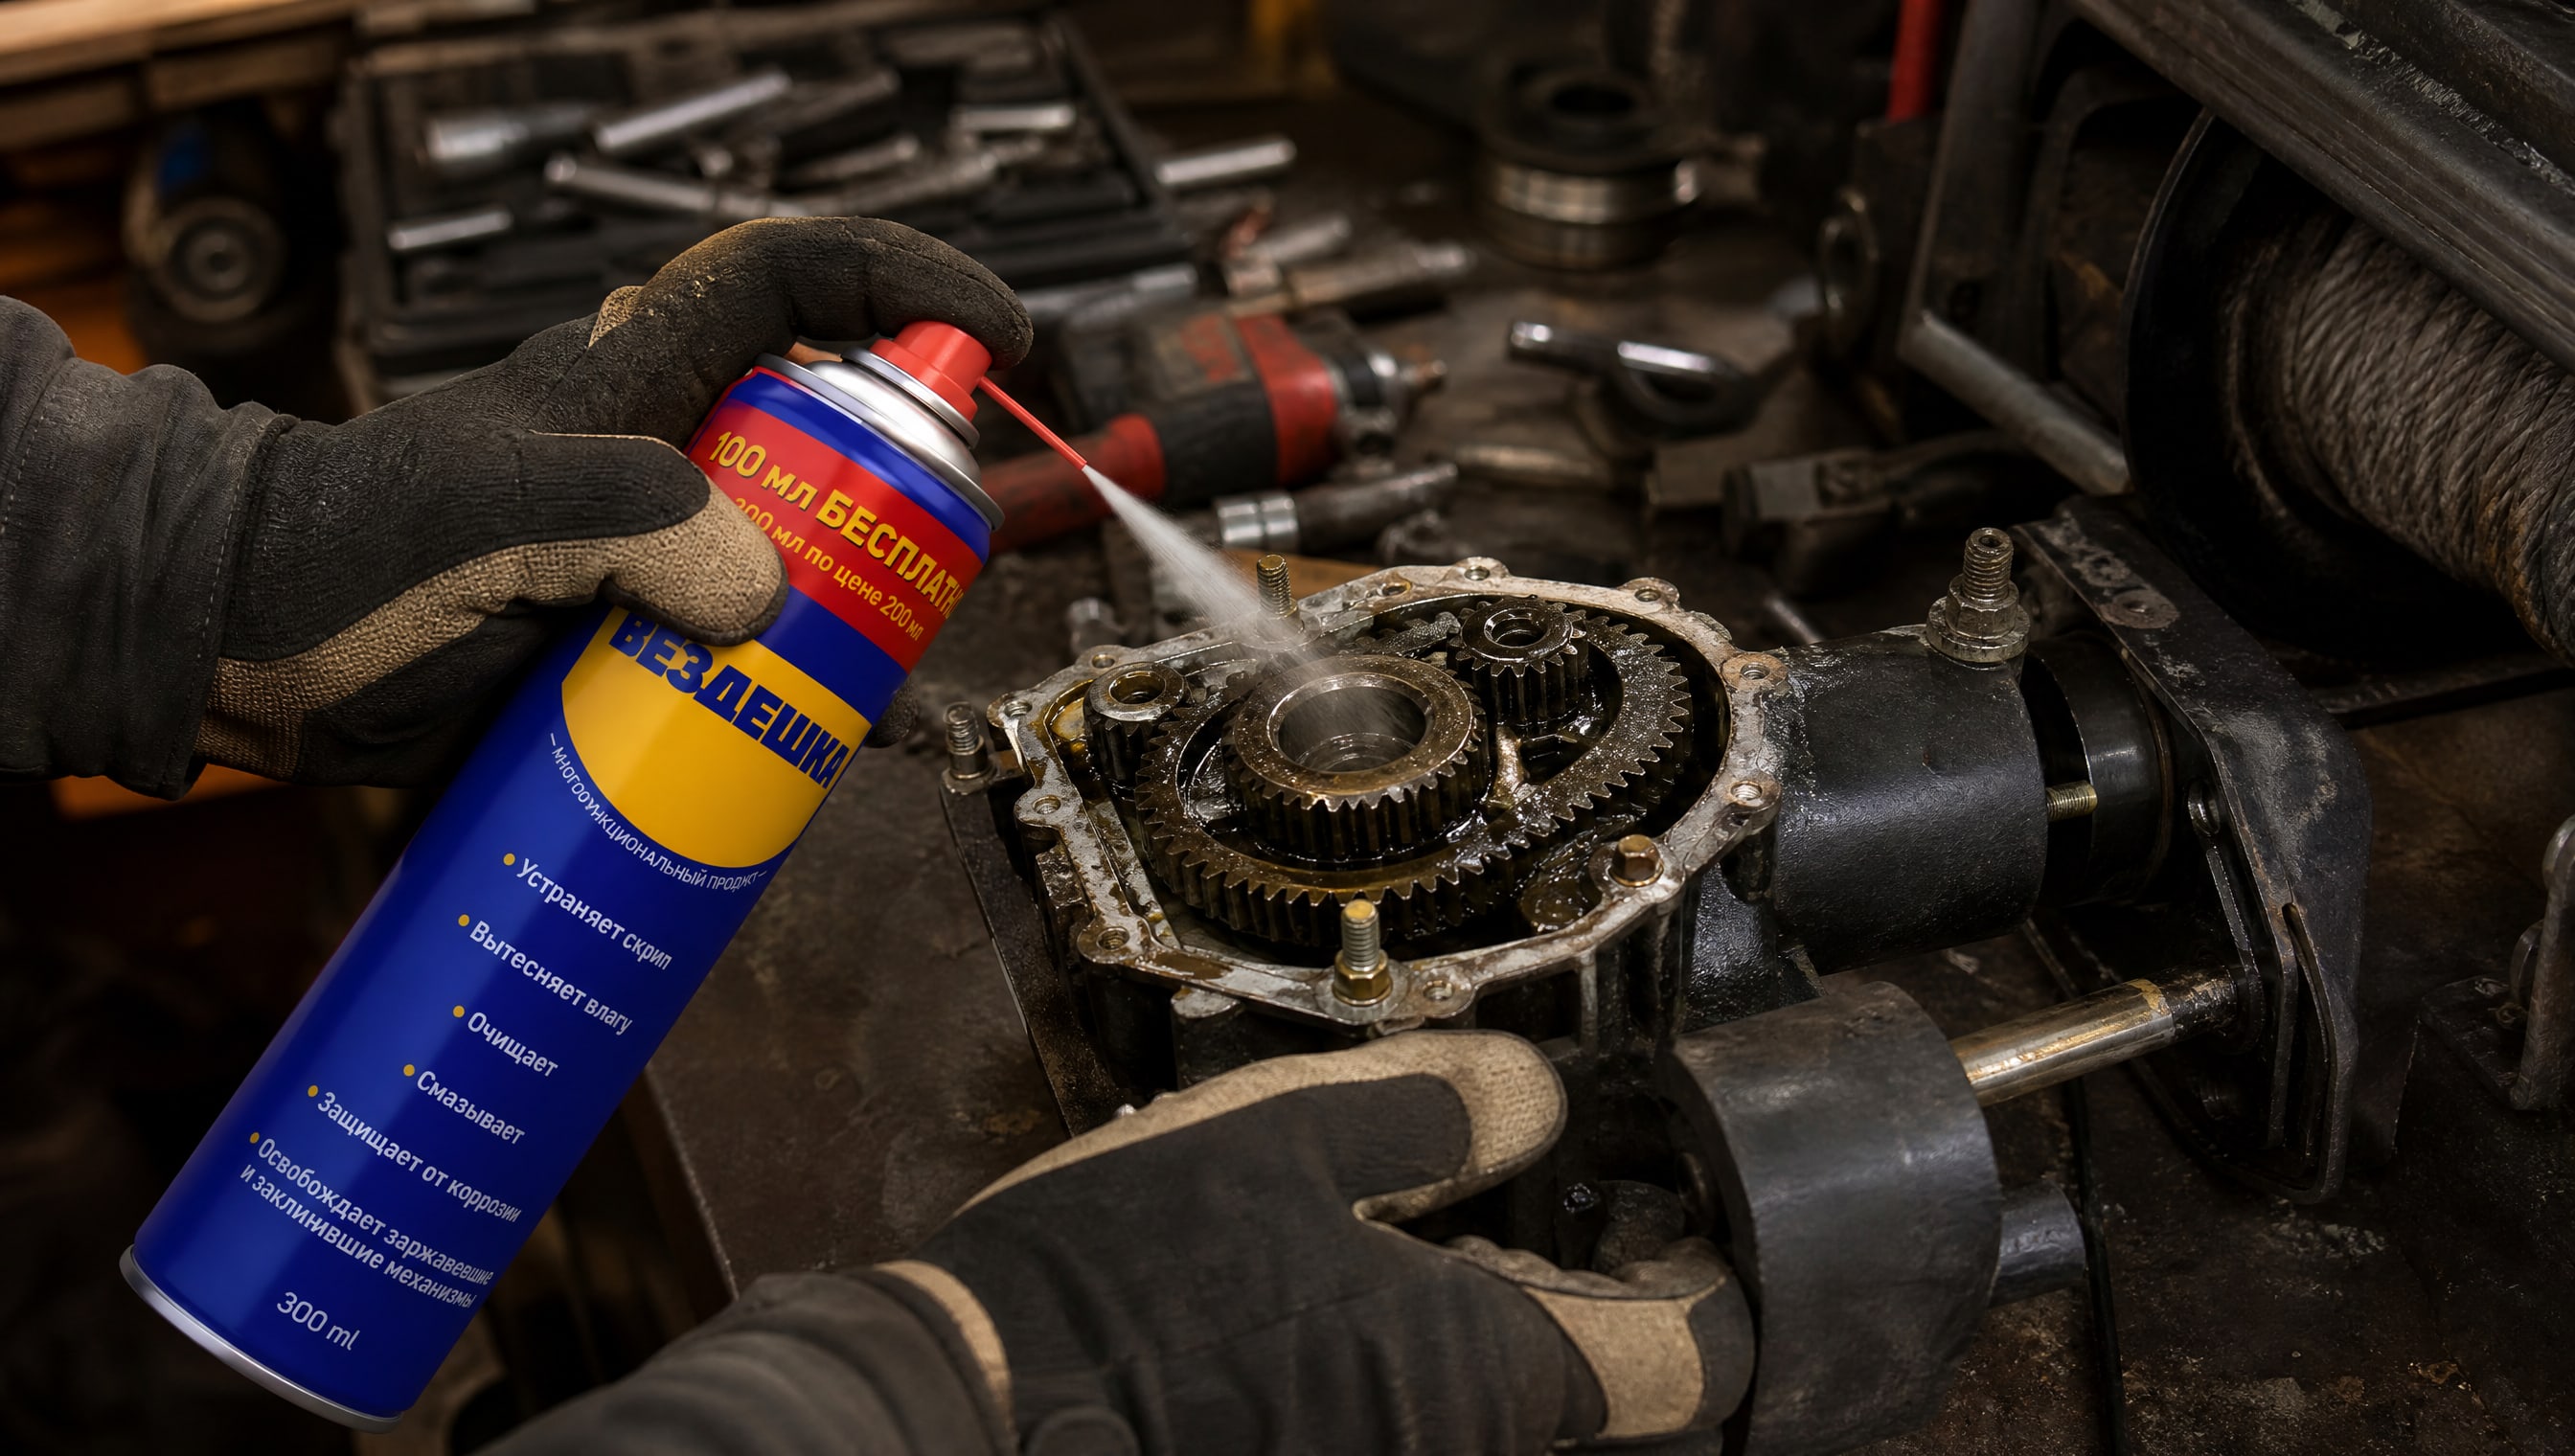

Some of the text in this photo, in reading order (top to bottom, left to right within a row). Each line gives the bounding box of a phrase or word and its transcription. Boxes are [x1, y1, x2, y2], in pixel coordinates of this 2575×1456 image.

[708, 431, 766, 477] 100
[804, 545, 834, 572] по
[832, 564, 882, 606] цене
[879, 595, 913, 630] 200
[608, 611, 850, 789] ВЕЗДЕШКА
[516, 857, 672, 970] Устраняет скрип
[469, 920, 633, 1035] Вытесняет влагу
[467, 1012, 558, 1078] Очищает
[317, 1091, 522, 1223] Защищает от коррозии
[417, 1070, 526, 1145] Смазывает
[239, 1164, 477, 1308] и заклинившие механизмы
[258, 1138, 494, 1286] Освобождает заржавевшие
[276, 1291, 360, 1351] 300 ml
